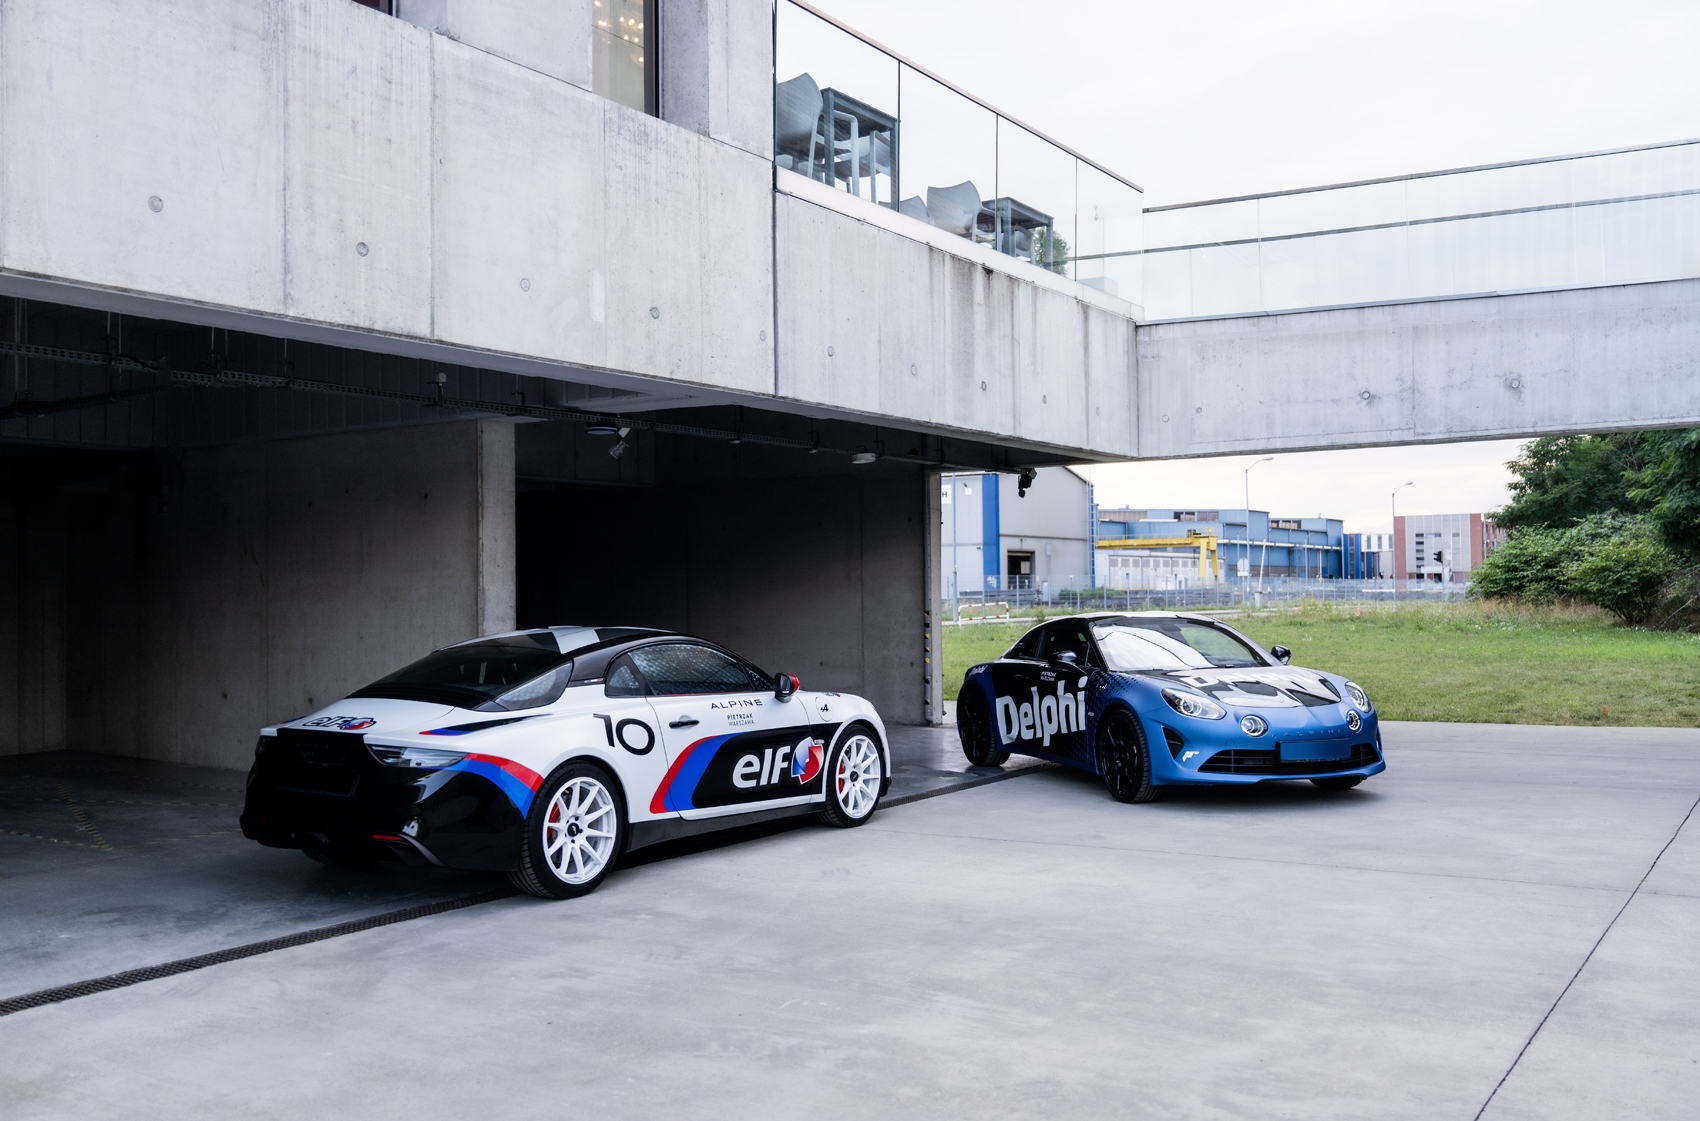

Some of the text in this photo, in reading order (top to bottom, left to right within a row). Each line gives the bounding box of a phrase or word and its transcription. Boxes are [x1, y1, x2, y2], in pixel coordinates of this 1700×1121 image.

[711, 698, 763, 710] ALPINE
[727, 712, 753, 720] PIETRZAK
[995, 676, 1089, 746] Delphi
[302, 716, 357, 728] elf
[728, 719, 755, 727] WARSZAWA
[593, 713, 656, 756] 10
[732, 745, 792, 789] elf
